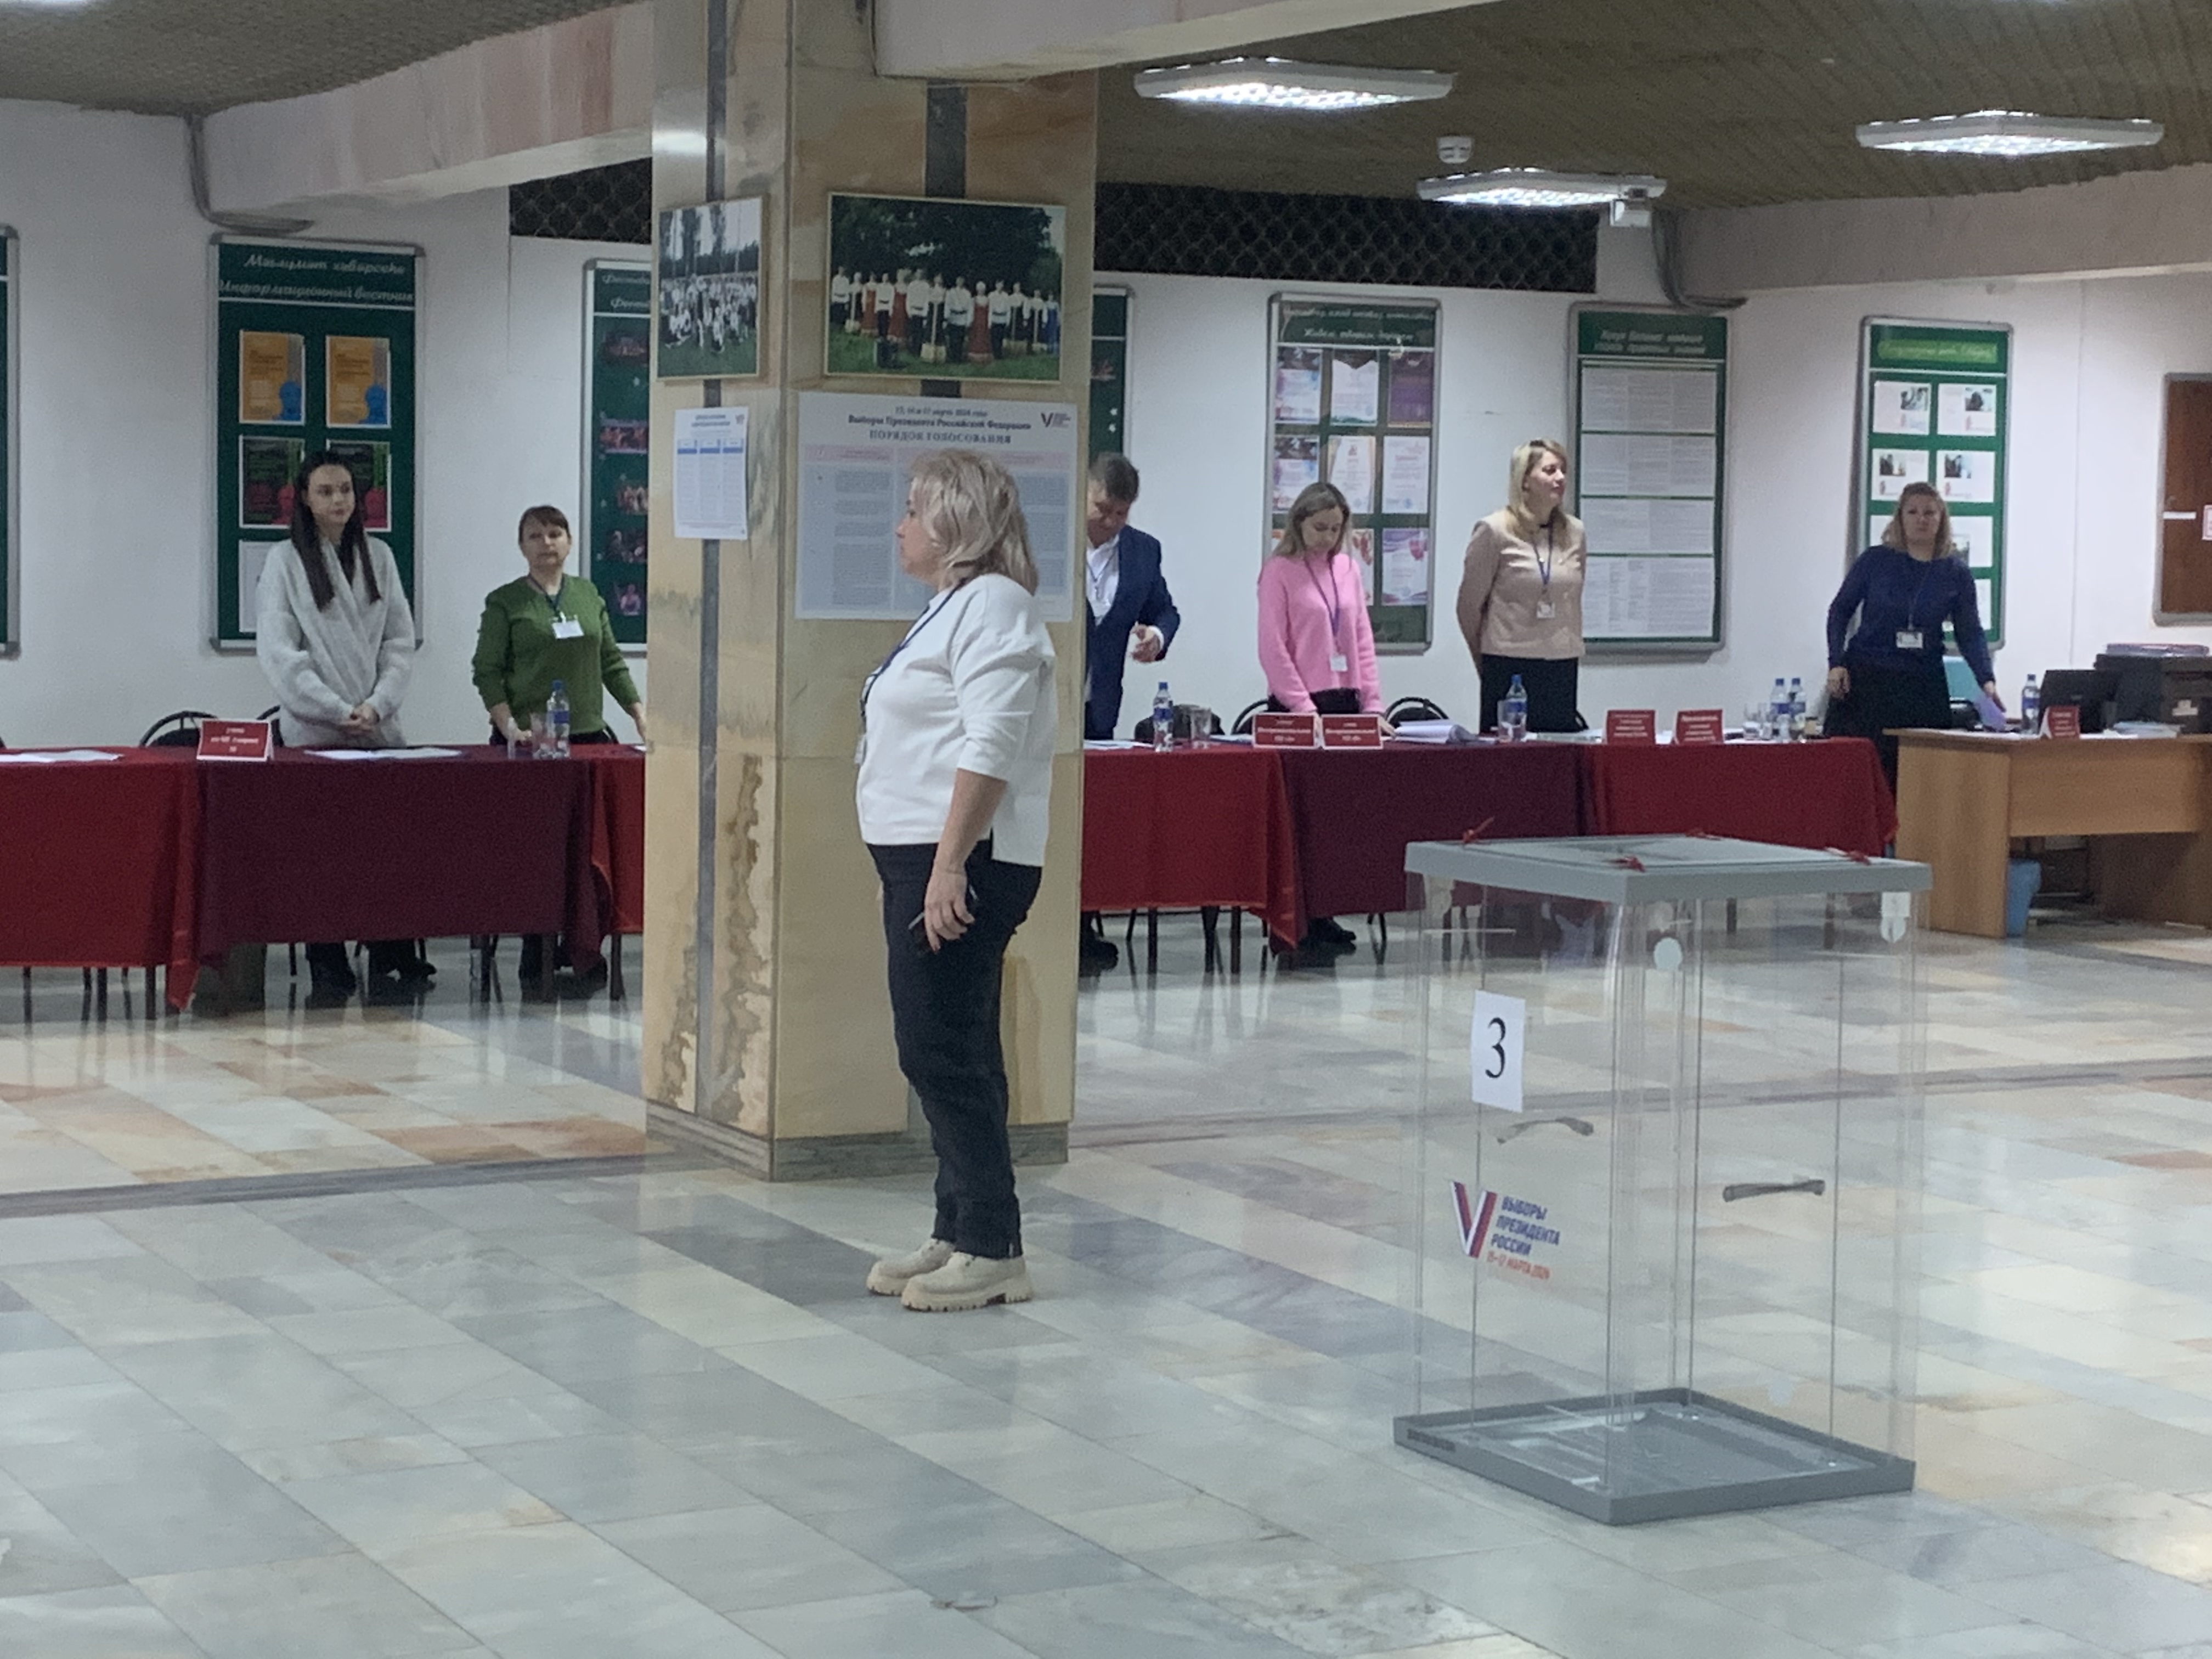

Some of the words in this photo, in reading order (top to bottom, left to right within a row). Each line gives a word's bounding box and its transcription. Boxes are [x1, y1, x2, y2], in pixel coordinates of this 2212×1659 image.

[870, 430, 924, 441] ПОРЯДОК
[927, 432, 1012, 444] ГОЛОСОВАНИЯ
[1485, 1018, 1506, 1079] 3
[1502, 1197, 1548, 1220] ВЫБОРЫ
[1496, 1215, 1560, 1245] ПРЕЗИДЕНТА
[1491, 1233, 1532, 1256] РОССИИ
